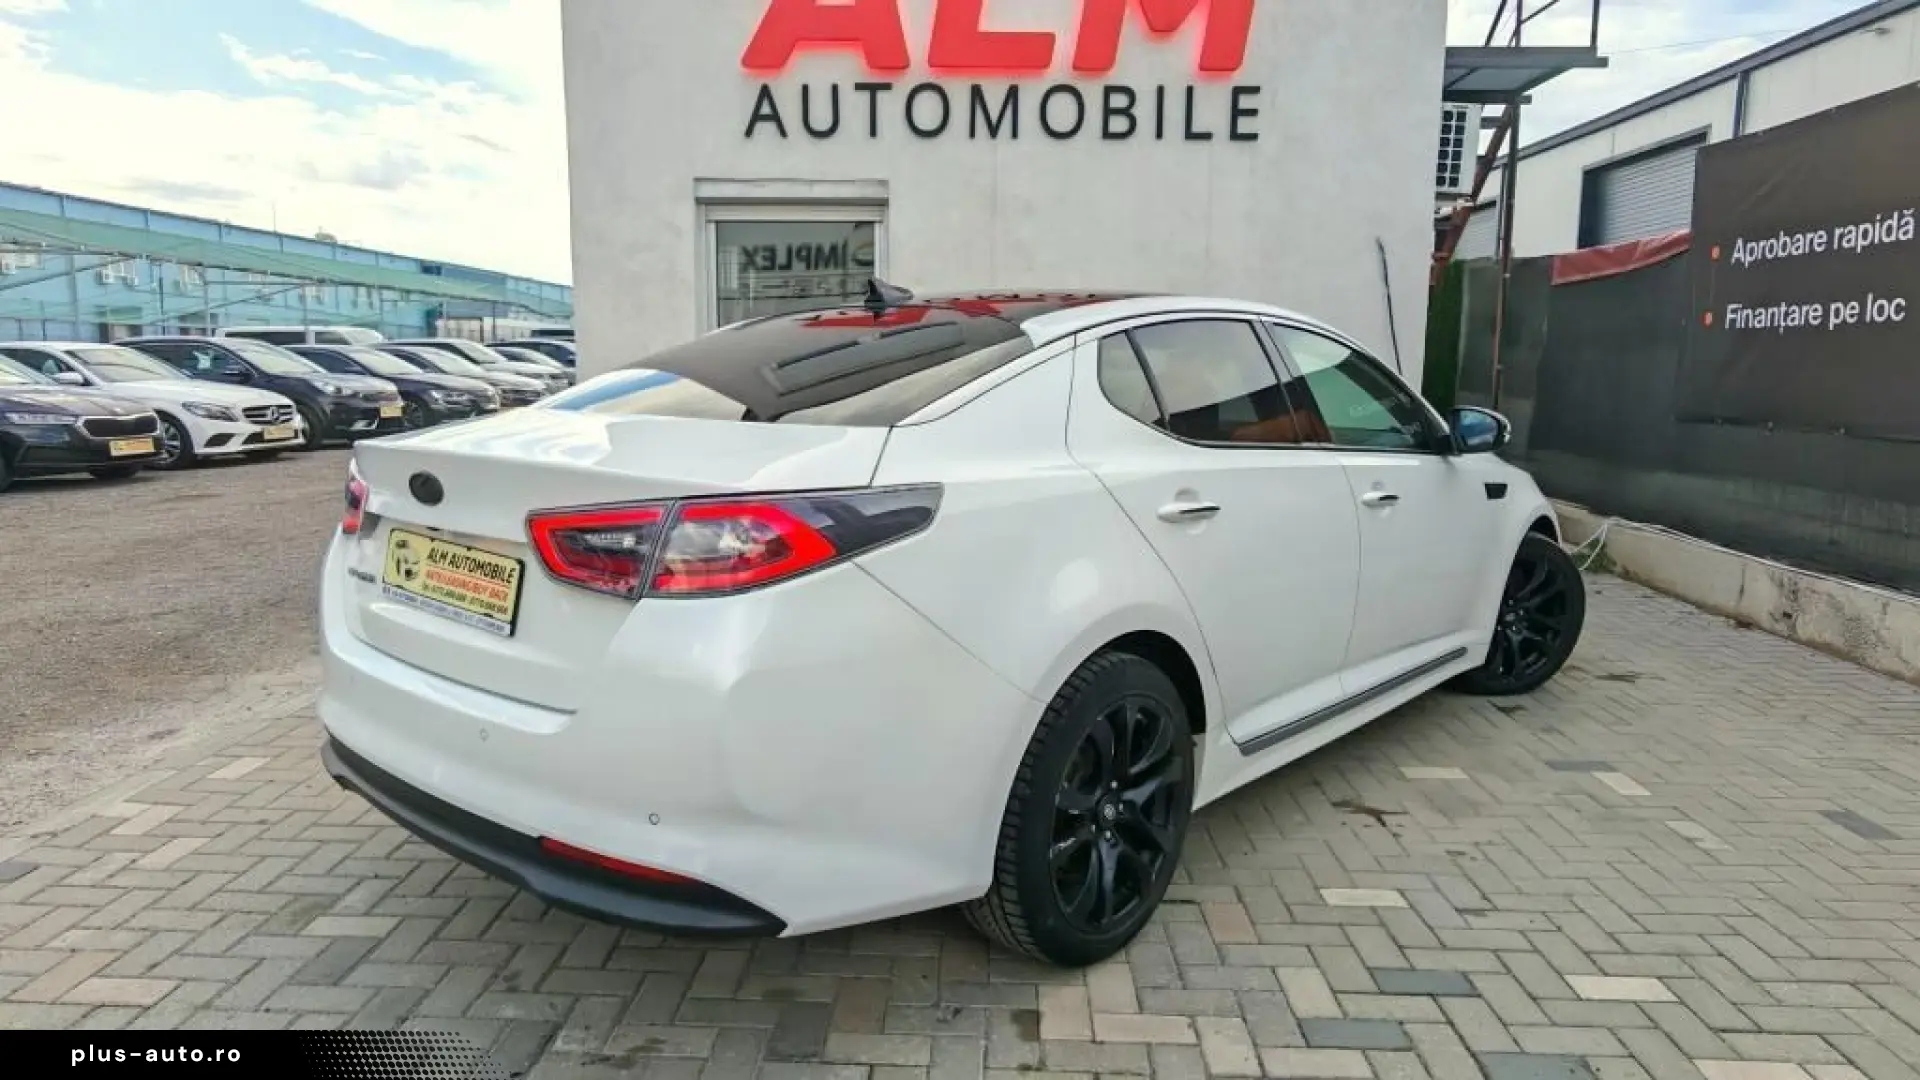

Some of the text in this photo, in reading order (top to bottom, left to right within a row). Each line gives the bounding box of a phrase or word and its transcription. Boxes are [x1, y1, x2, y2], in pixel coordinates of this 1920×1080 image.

[744, 82, 1262, 141] AUTOMOBILE
[1731, 208, 1915, 268] Aprobare rapidă
[1725, 292, 1906, 335] Finanțare pe loc
[447, 552, 516, 584] AUTOMOBILE
